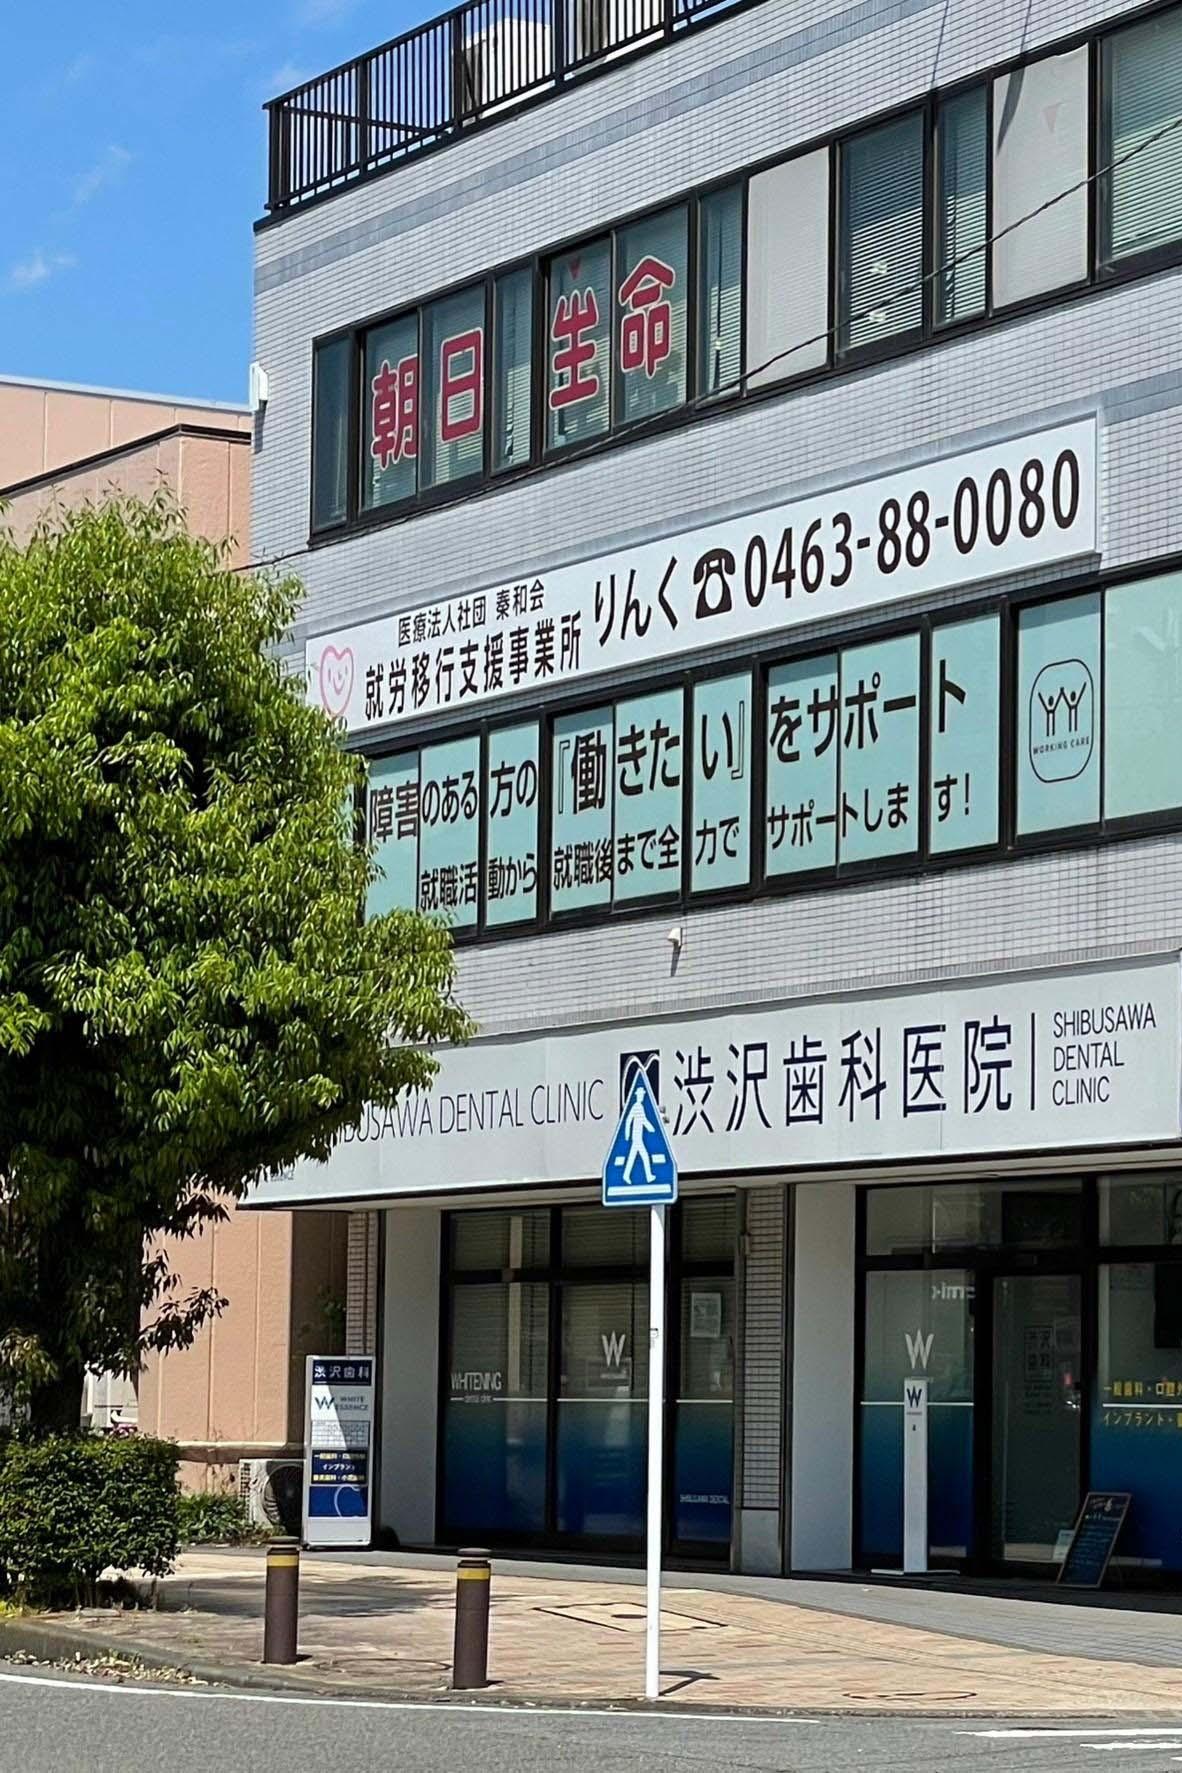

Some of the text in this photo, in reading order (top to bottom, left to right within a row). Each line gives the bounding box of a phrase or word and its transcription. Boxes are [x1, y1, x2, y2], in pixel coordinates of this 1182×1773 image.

[370, 255, 676, 470] 朝日生命
[364, 449, 1080, 720] 就労移行支援事業所 りんく 0463-88-0080
[398, 595, 486, 647] 医療法人社団
[1033, 741, 1067, 755] WORKING
[1053, 1002, 1157, 1038] SHIBUSAWA
[673, 1014, 1013, 1136] 渋沢歯科医院
[1053, 1041, 1125, 1071] DENTAL
[338, 1078, 604, 1143] USAWA DENTAL CLINIC
[1052, 1076, 1111, 1106] CLINIC
[601, 1330, 626, 1368] W
[905, 1329, 934, 1369] W
[450, 1371, 502, 1391] WHITENING
